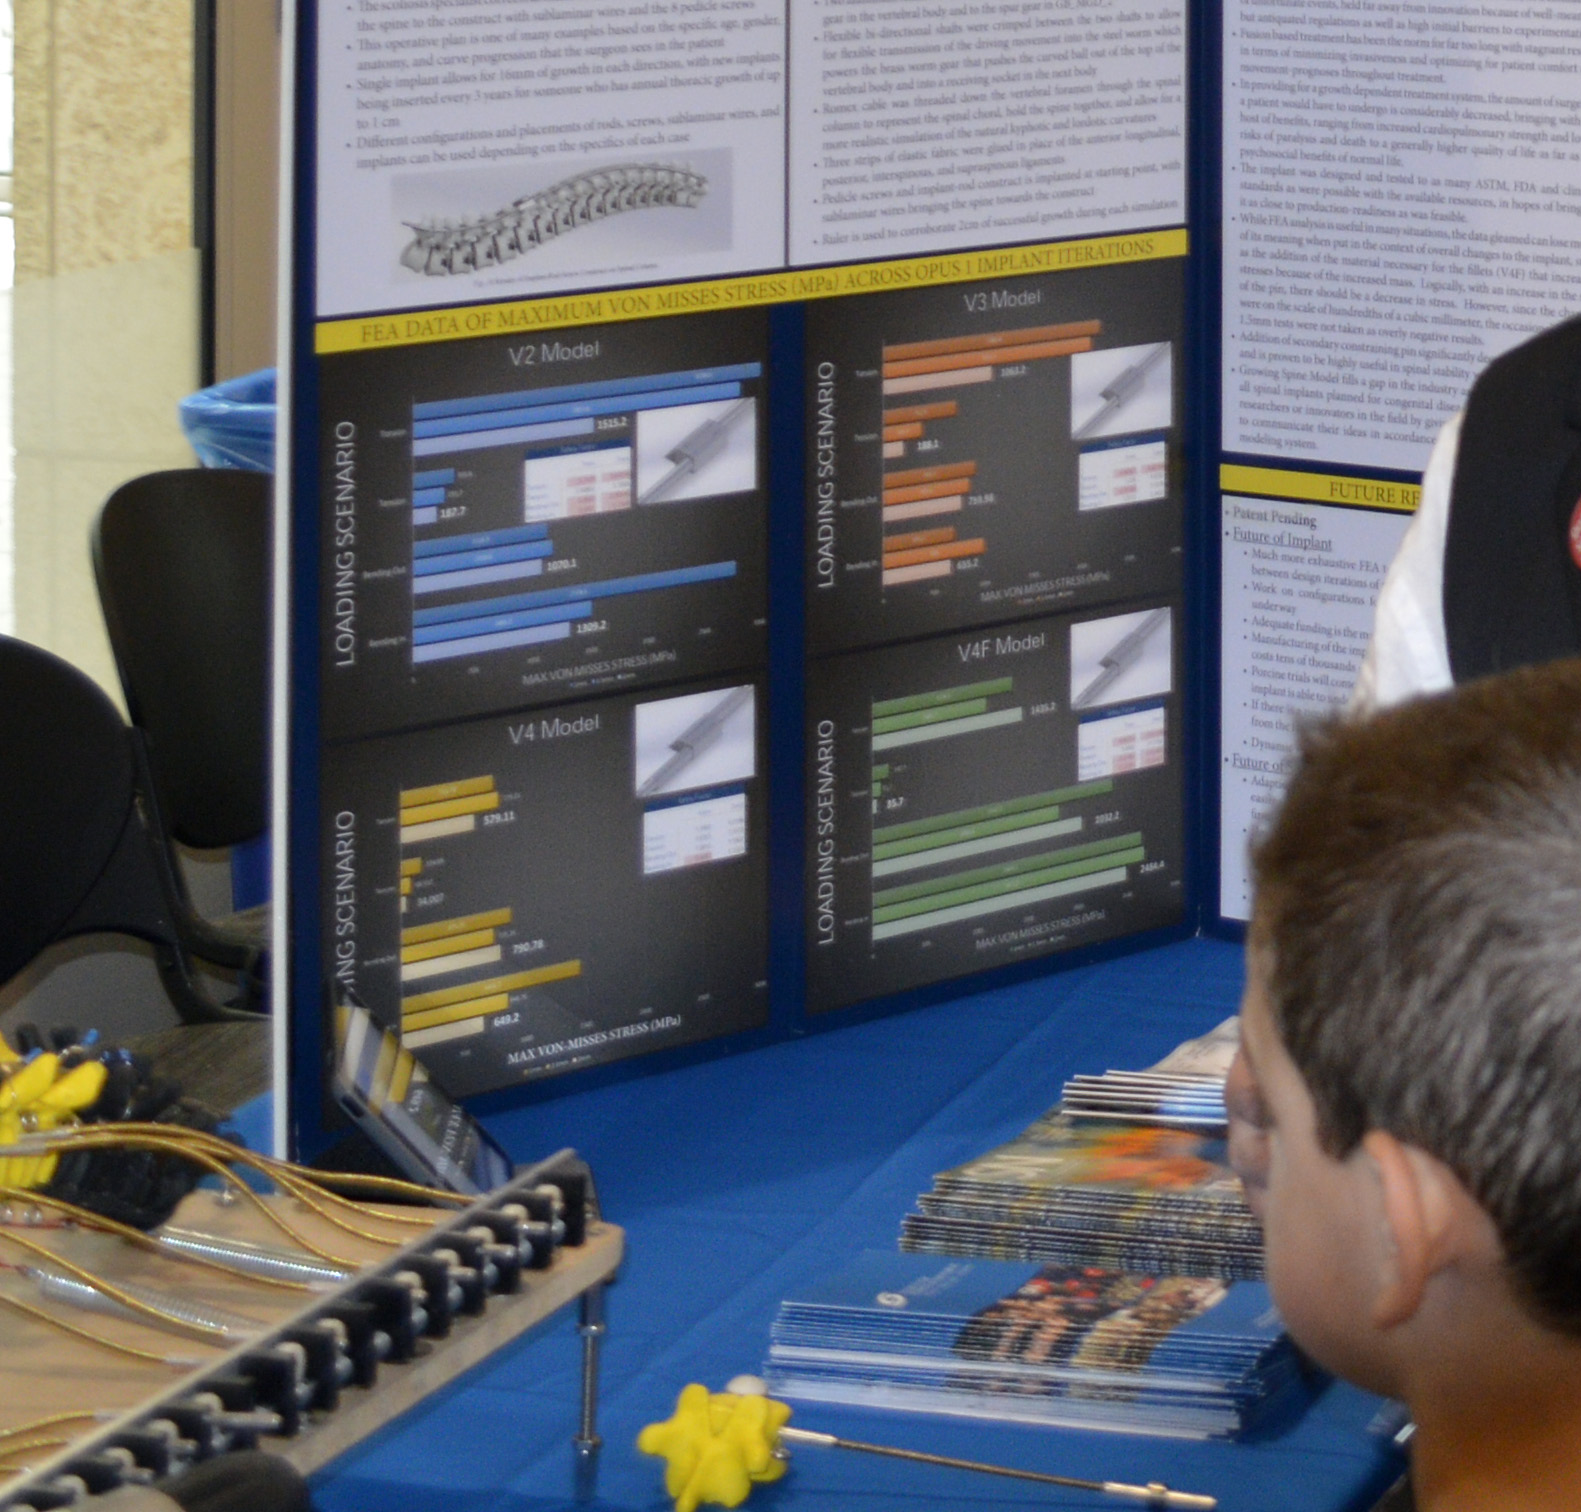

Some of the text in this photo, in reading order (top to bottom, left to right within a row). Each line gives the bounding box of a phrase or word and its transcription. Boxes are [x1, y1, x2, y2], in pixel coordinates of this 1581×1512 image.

[362, 238, 1154, 343] FEA DATA OF MAXIMUM VON MISSES STRESS (MPa) ACROSS OPUS 1 IMPLANT ITERATIONS
[964, 289, 1040, 312] V3 Model
[509, 341, 599, 366] V2 Model
[818, 361, 836, 588] LOADING SCENARIO
[1329, 480, 1396, 503] FUTURE
[1233, 506, 1317, 530] Patent Pending
[336, 421, 355, 667] LOADING SCENARIO
[1233, 526, 1332, 553] Future of Implant
[958, 633, 1044, 661] V4F Model
[522, 650, 676, 685] MAX VON MISSES STRESS (MPa)
[509, 714, 599, 744] V4 Model
[1232, 753, 1286, 776] Future of
[818, 719, 836, 945] LOADING SCENARIO
[336, 810, 355, 944] SCENARIO
[508, 1015, 681, 1064] MAX VON-MISSES STRESS (MPa)
